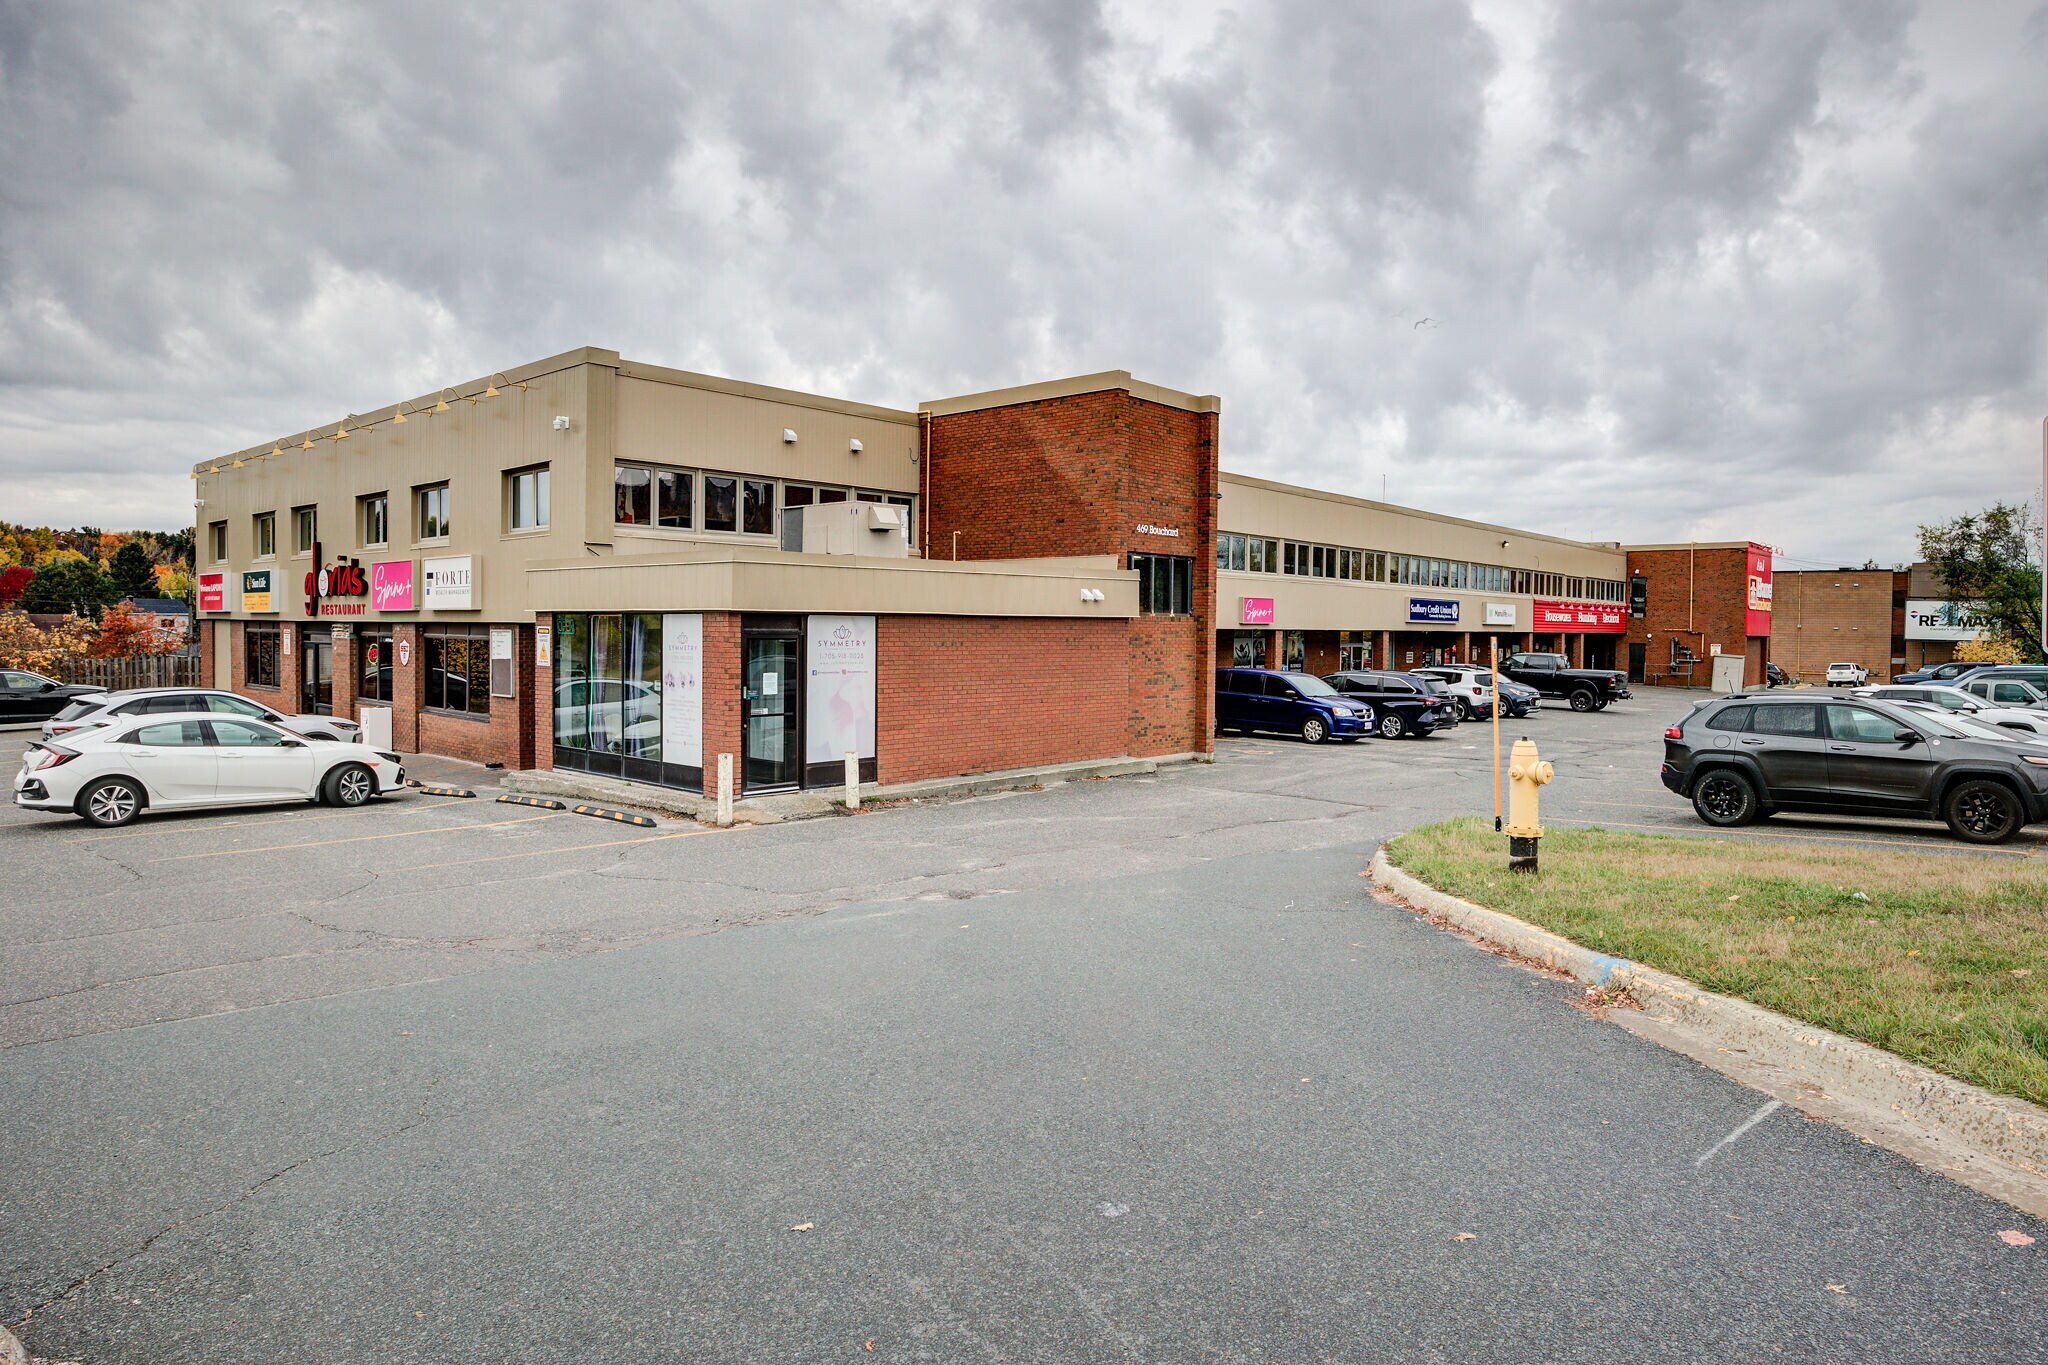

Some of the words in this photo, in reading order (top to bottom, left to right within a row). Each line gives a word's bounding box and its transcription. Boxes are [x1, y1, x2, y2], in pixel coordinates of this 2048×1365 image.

[1136, 524, 1148, 533] 469
[1149, 525, 1179, 537] Bouchard
[435, 569, 471, 586] FORTE
[321, 603, 366, 616] RESTAURANT
[1410, 603, 1427, 616] Sudbury
[1427, 604, 1440, 614] Credit
[1440, 606, 1452, 615] Union
[818, 640, 866, 648] SYMMETRY
